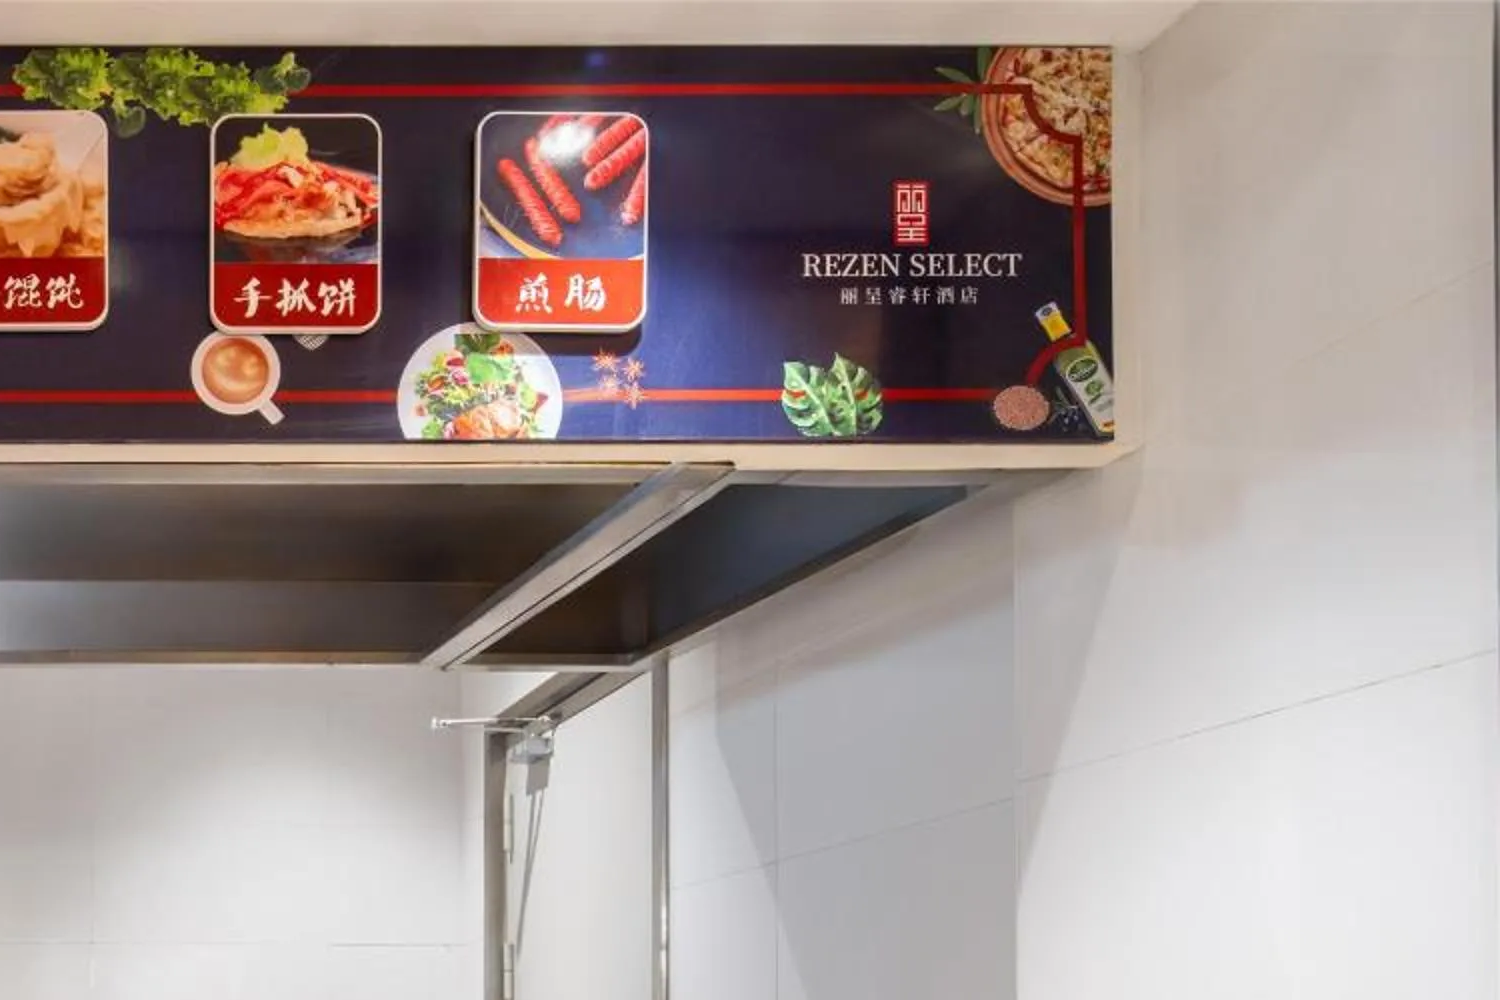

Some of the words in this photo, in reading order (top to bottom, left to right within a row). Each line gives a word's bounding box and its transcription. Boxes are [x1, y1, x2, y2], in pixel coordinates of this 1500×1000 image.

[801, 253, 900, 277] REZEN
[909, 253, 1023, 277] SELECT
[233, 277, 357, 319] 手抓饼
[515, 271, 607, 314] 煎肠
[841, 286, 979, 305] 丽呈睿轩酒店
